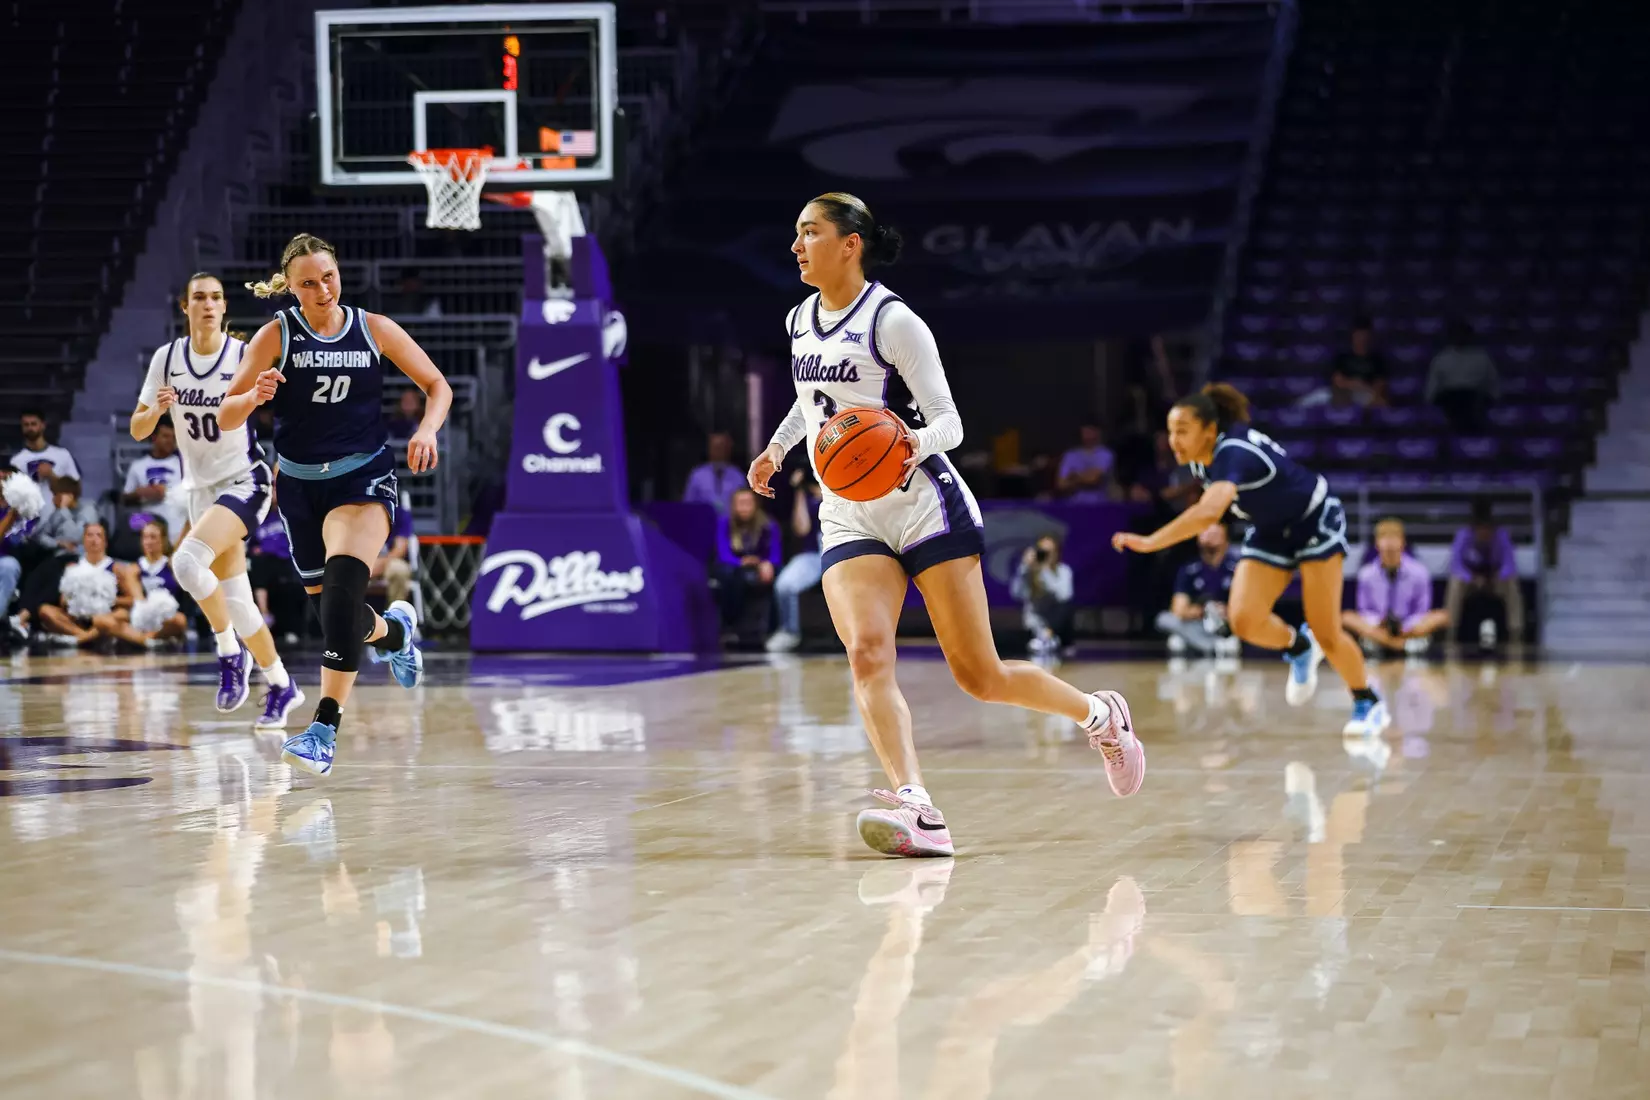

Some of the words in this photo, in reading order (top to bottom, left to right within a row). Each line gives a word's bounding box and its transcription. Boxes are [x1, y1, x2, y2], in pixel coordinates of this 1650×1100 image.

[292, 351, 371, 368] WASHBURN
[793, 353, 861, 383] Wildcats
[172, 386, 226, 407] Wildcat
[312, 375, 351, 403] 20
[184, 412, 221, 442] 30
[817, 414, 861, 455] ELITE
[479, 550, 644, 613] Dillons
